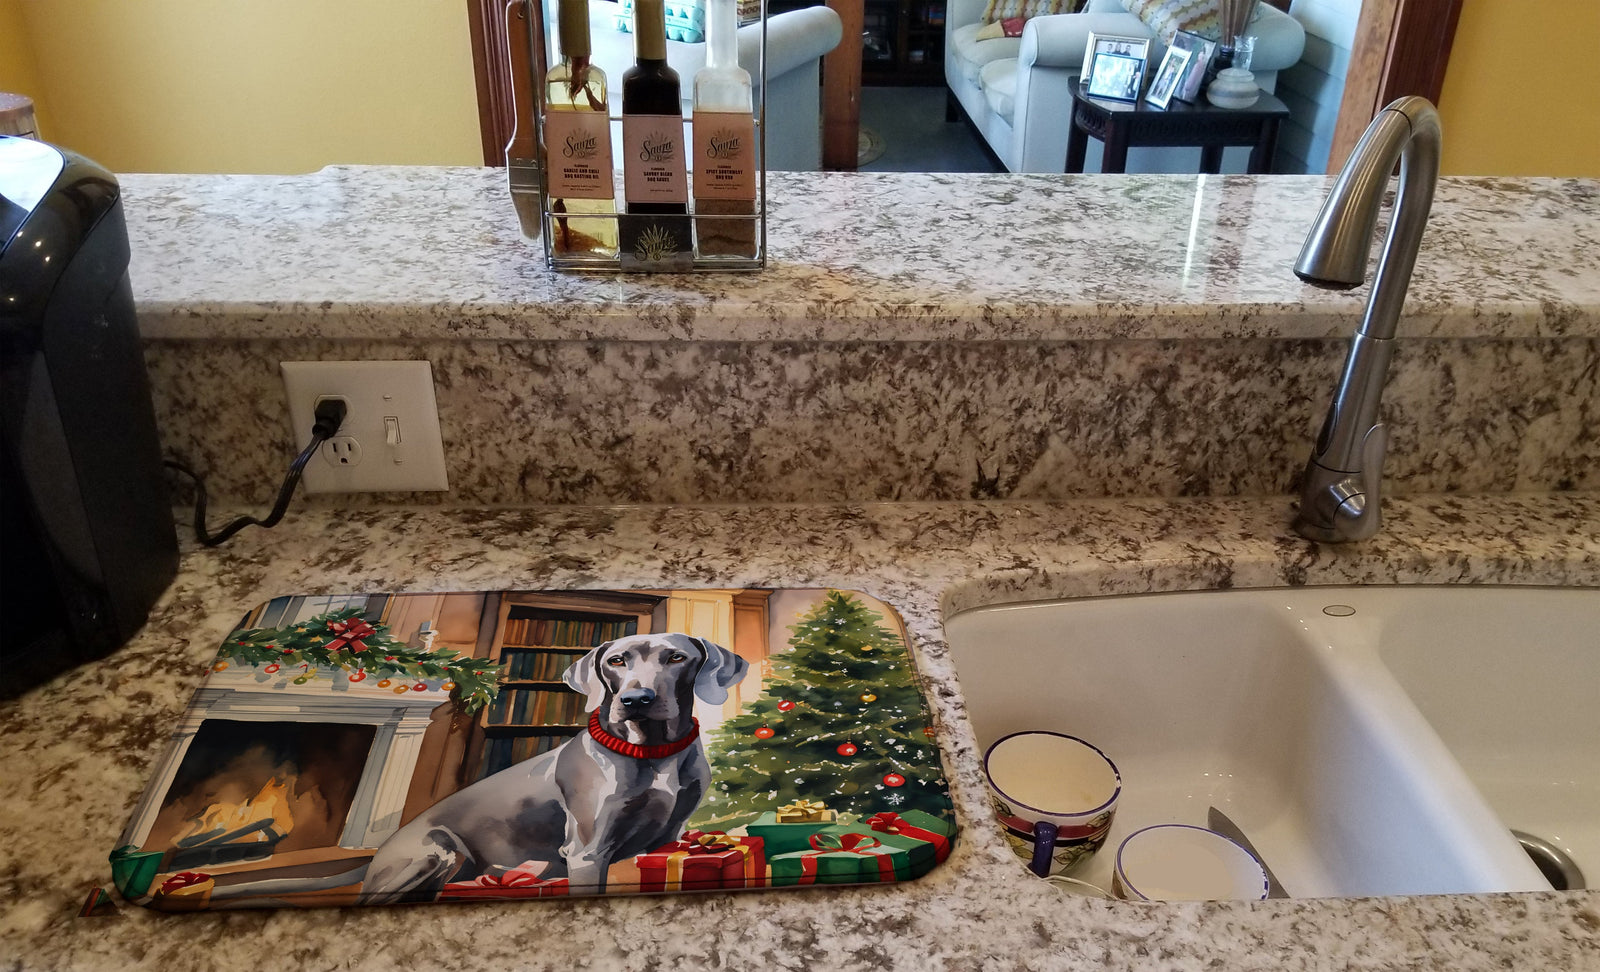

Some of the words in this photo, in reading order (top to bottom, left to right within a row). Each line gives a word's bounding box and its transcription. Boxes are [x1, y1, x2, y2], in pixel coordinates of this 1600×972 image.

[563, 136, 597, 158] Sauza
[640, 140, 673, 161] Sauza
[707, 137, 739, 158] Sauza
